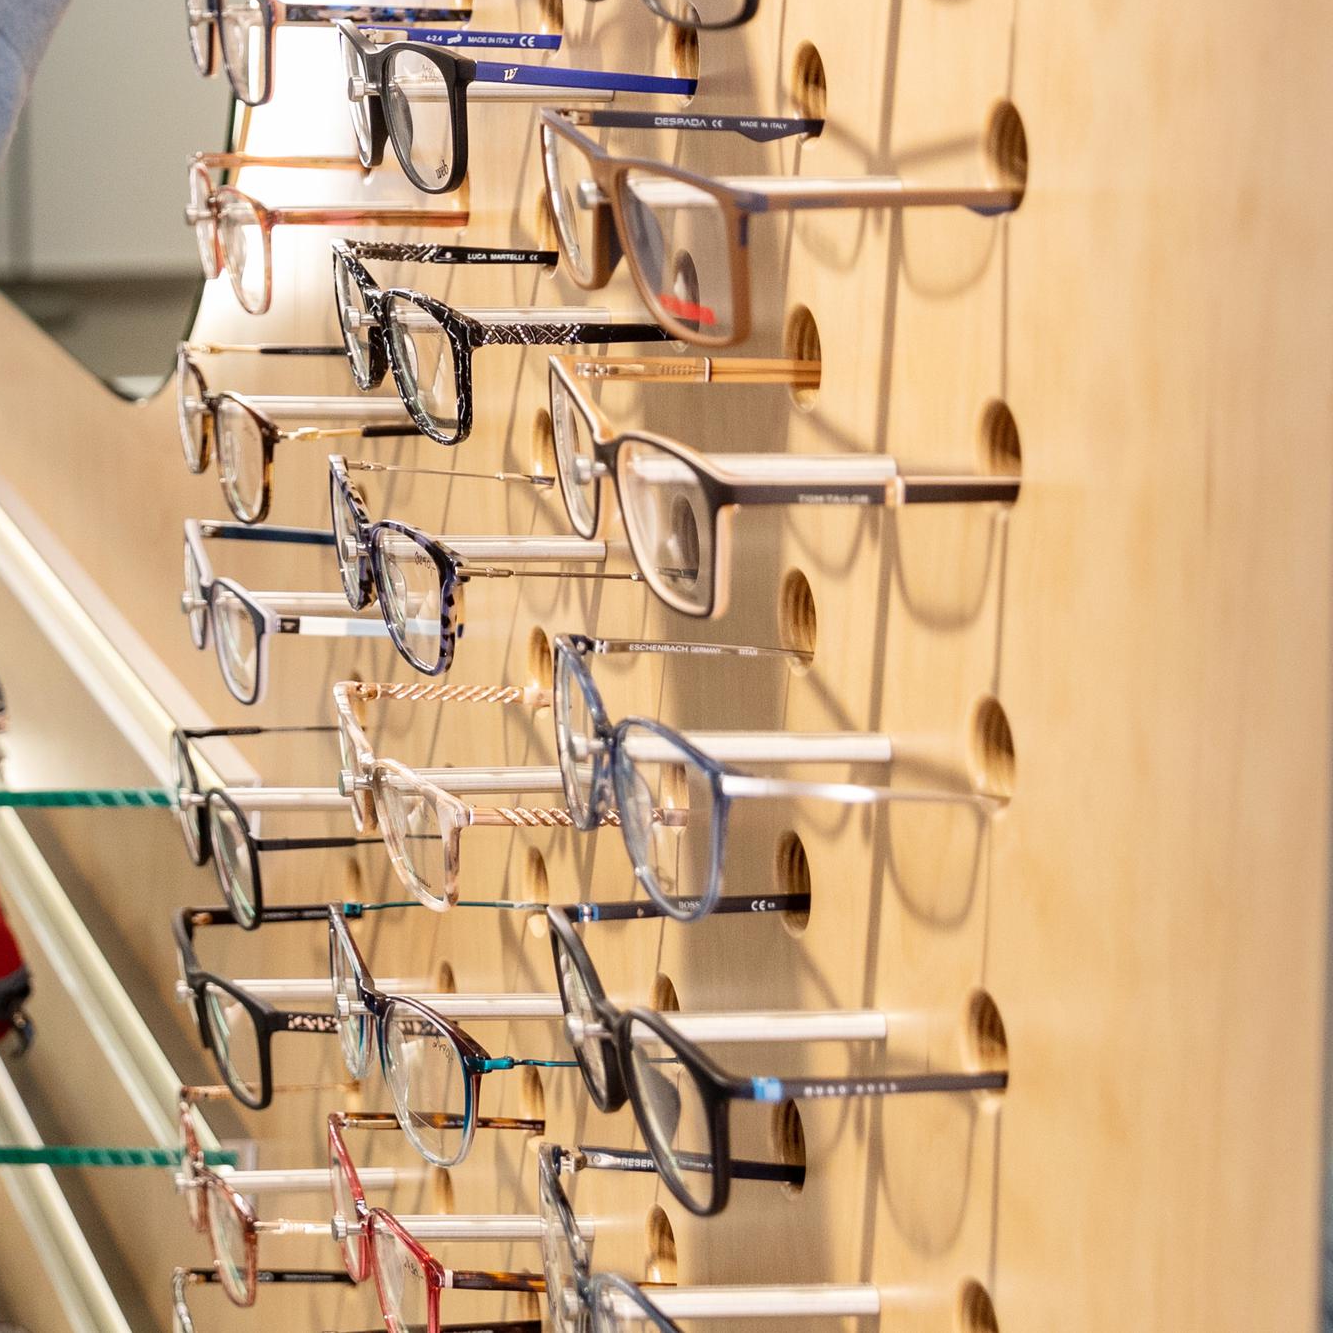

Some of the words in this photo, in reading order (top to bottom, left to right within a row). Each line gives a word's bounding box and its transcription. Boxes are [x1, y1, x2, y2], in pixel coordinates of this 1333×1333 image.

[467, 36, 486, 44] MADE
[488, 36, 495, 44] IN
[496, 37, 515, 45] ITALY
[654, 116, 707, 128] DESPADA
[740, 120, 758, 128] MADE
[770, 122, 787, 130] ITALY
[490, 253, 526, 261] MARTELLI
[629, 644, 688, 653] ESCHENBACH
[621, 1157, 654, 1168] RESER
